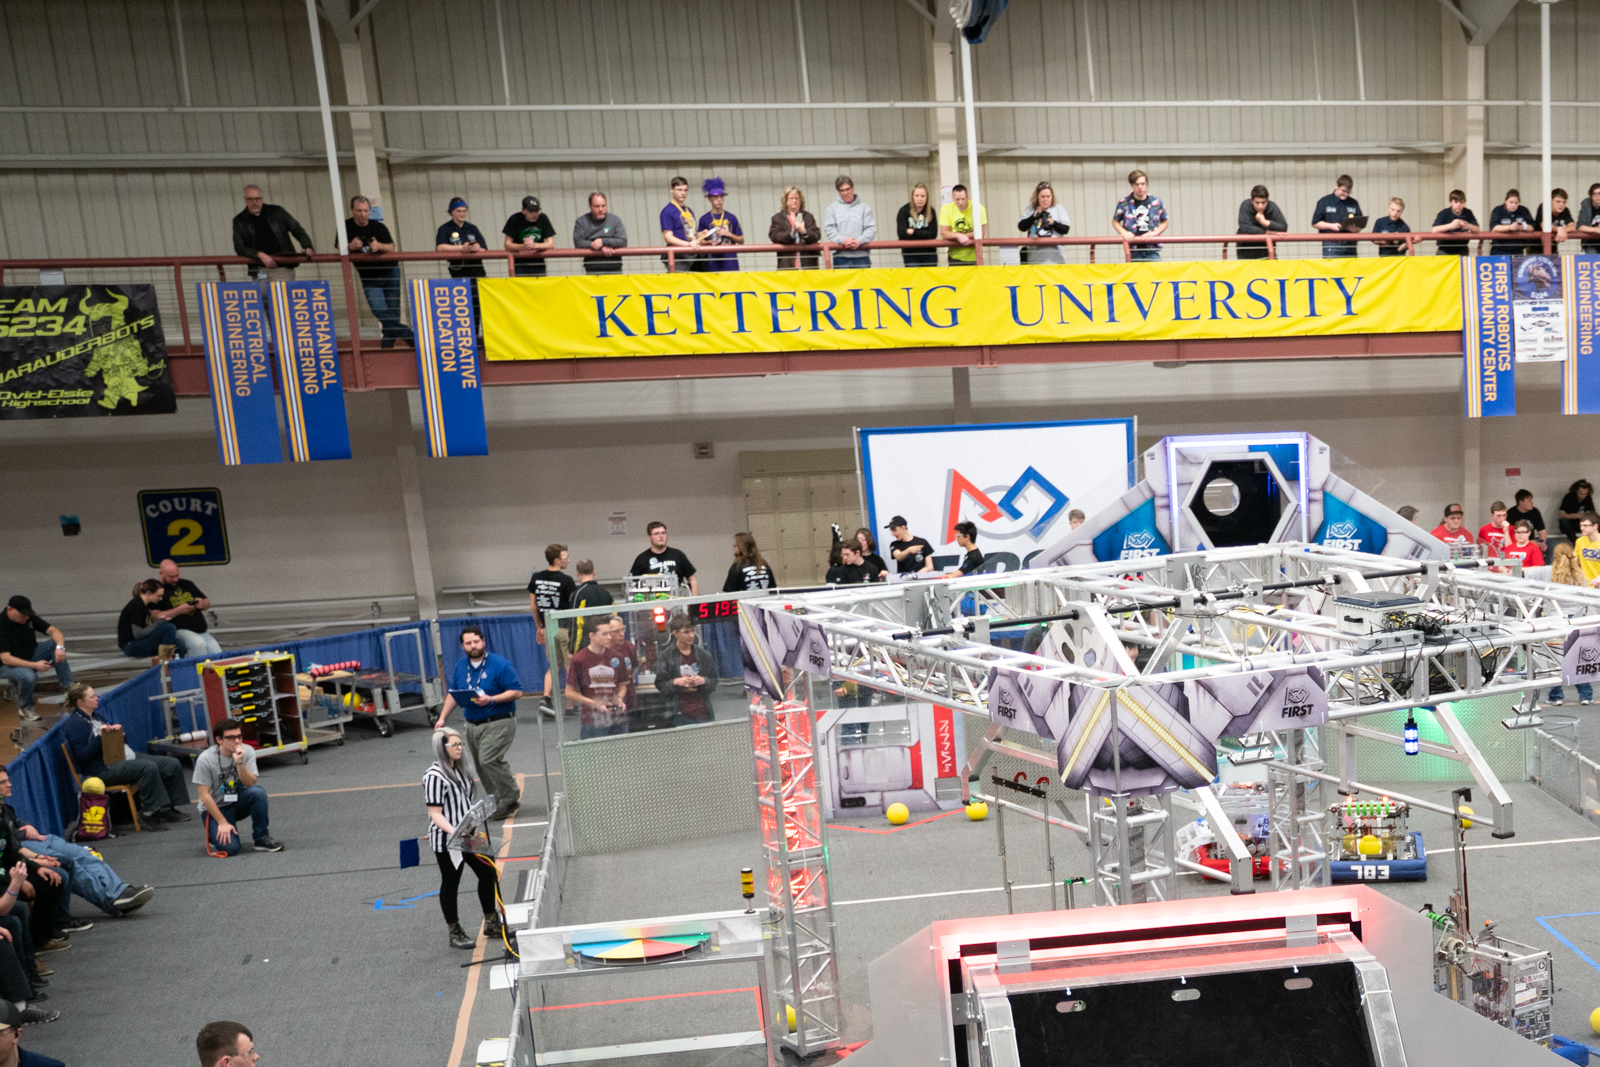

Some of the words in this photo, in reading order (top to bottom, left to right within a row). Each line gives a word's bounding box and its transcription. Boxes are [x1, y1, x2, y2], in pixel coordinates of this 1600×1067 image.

[591, 285, 962, 338] KETTERING
[1004, 277, 1364, 326] UNIVERSITY
[1479, 262, 1497, 344] COMMUNITY
[1494, 262, 1508, 301] FIRST
[1578, 262, 1593, 355] ENGINEERING
[222, 290, 250, 397] ENGINEERING
[242, 290, 268, 384] ELECTRICAL
[292, 288, 319, 395] ENGINEERING
[310, 287, 337, 390] MECHANICAL
[434, 286, 457, 372] EDUCATION
[452, 285, 477, 389] COOPERATIVE
[1497, 305, 1511, 372] ROBOTICS
[1483, 347, 1498, 402] CENTER
[145, 498, 218, 518] COURT
[167, 518, 206, 556] 2
[1120, 548, 1160, 561] FIRST
[1322, 538, 1362, 552] FIRST
[809, 654, 825, 667] FIRST
[997, 705, 1017, 719] FIRST
[1281, 704, 1314, 719] FIRST
